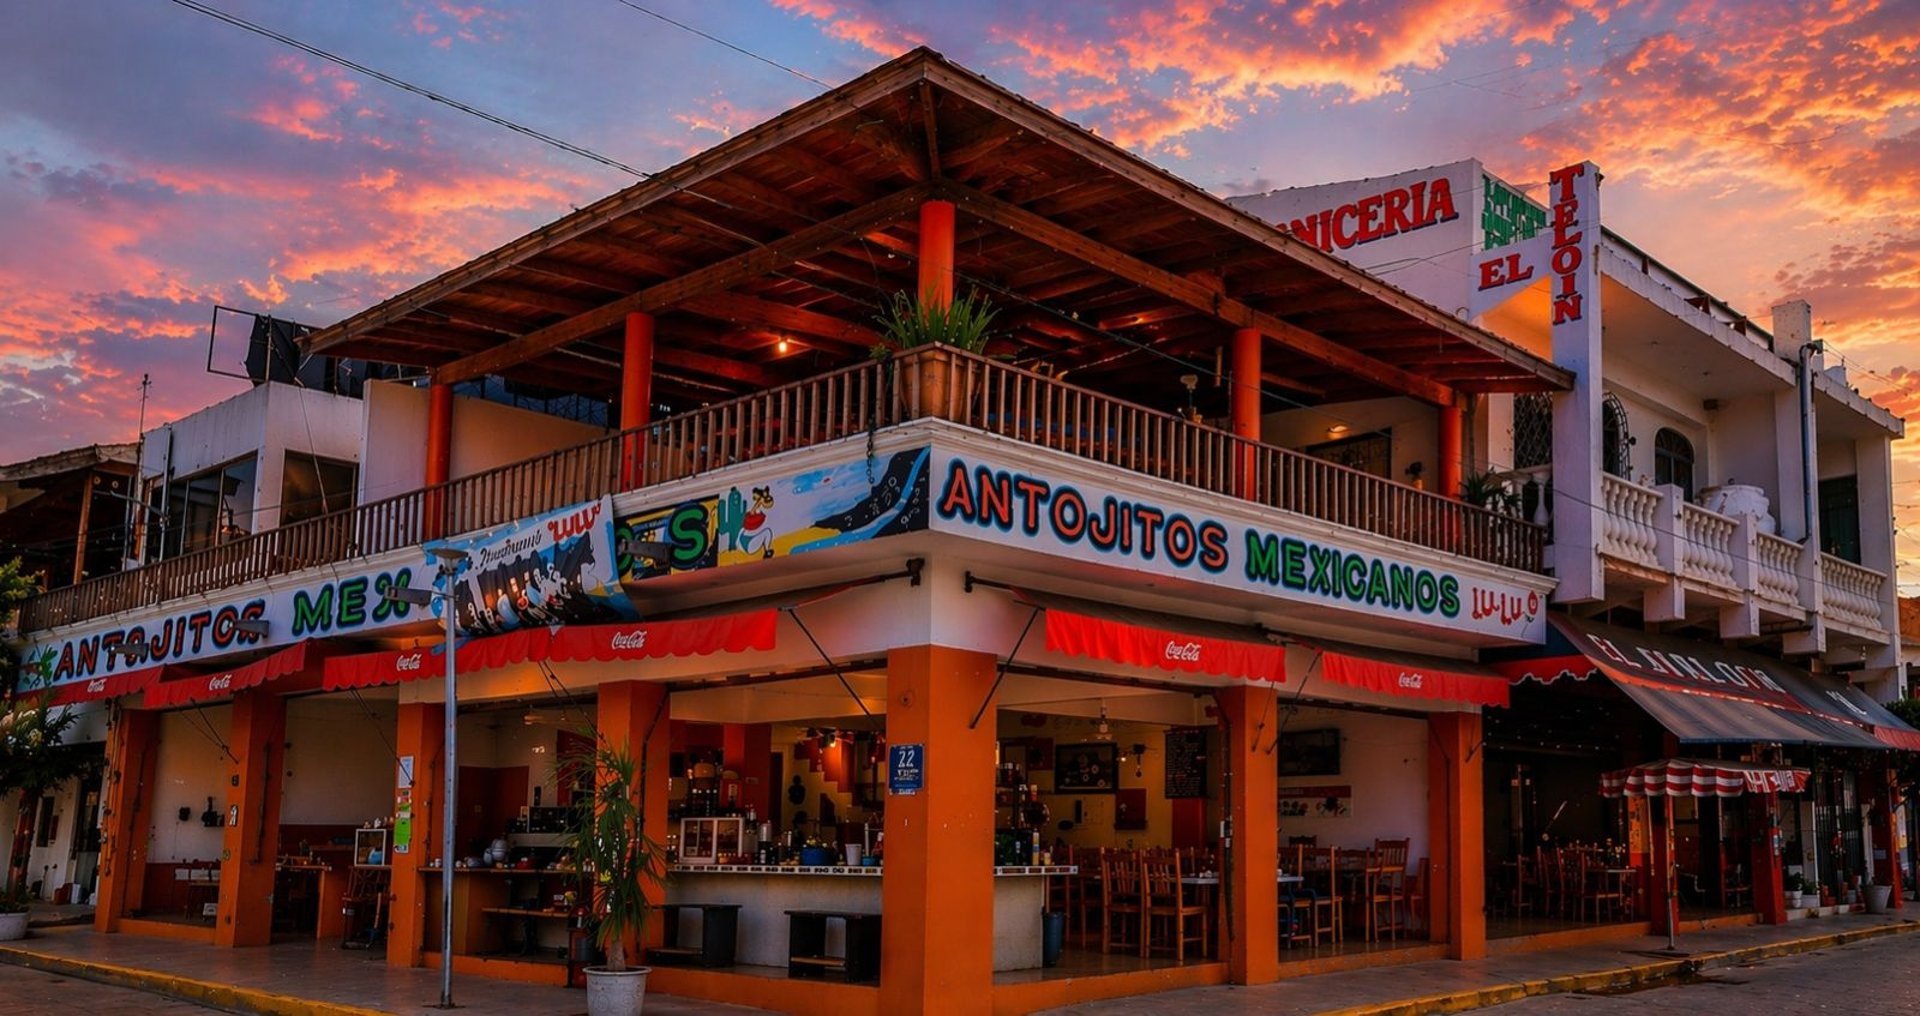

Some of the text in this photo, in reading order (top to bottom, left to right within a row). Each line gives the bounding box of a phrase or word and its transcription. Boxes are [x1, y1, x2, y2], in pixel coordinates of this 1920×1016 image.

[1478, 253, 1534, 291] EL
[938, 458, 1230, 573] ANTOJITOS
[1245, 528, 1460, 618] MEXICANOS
[898, 750, 915, 768] 22
